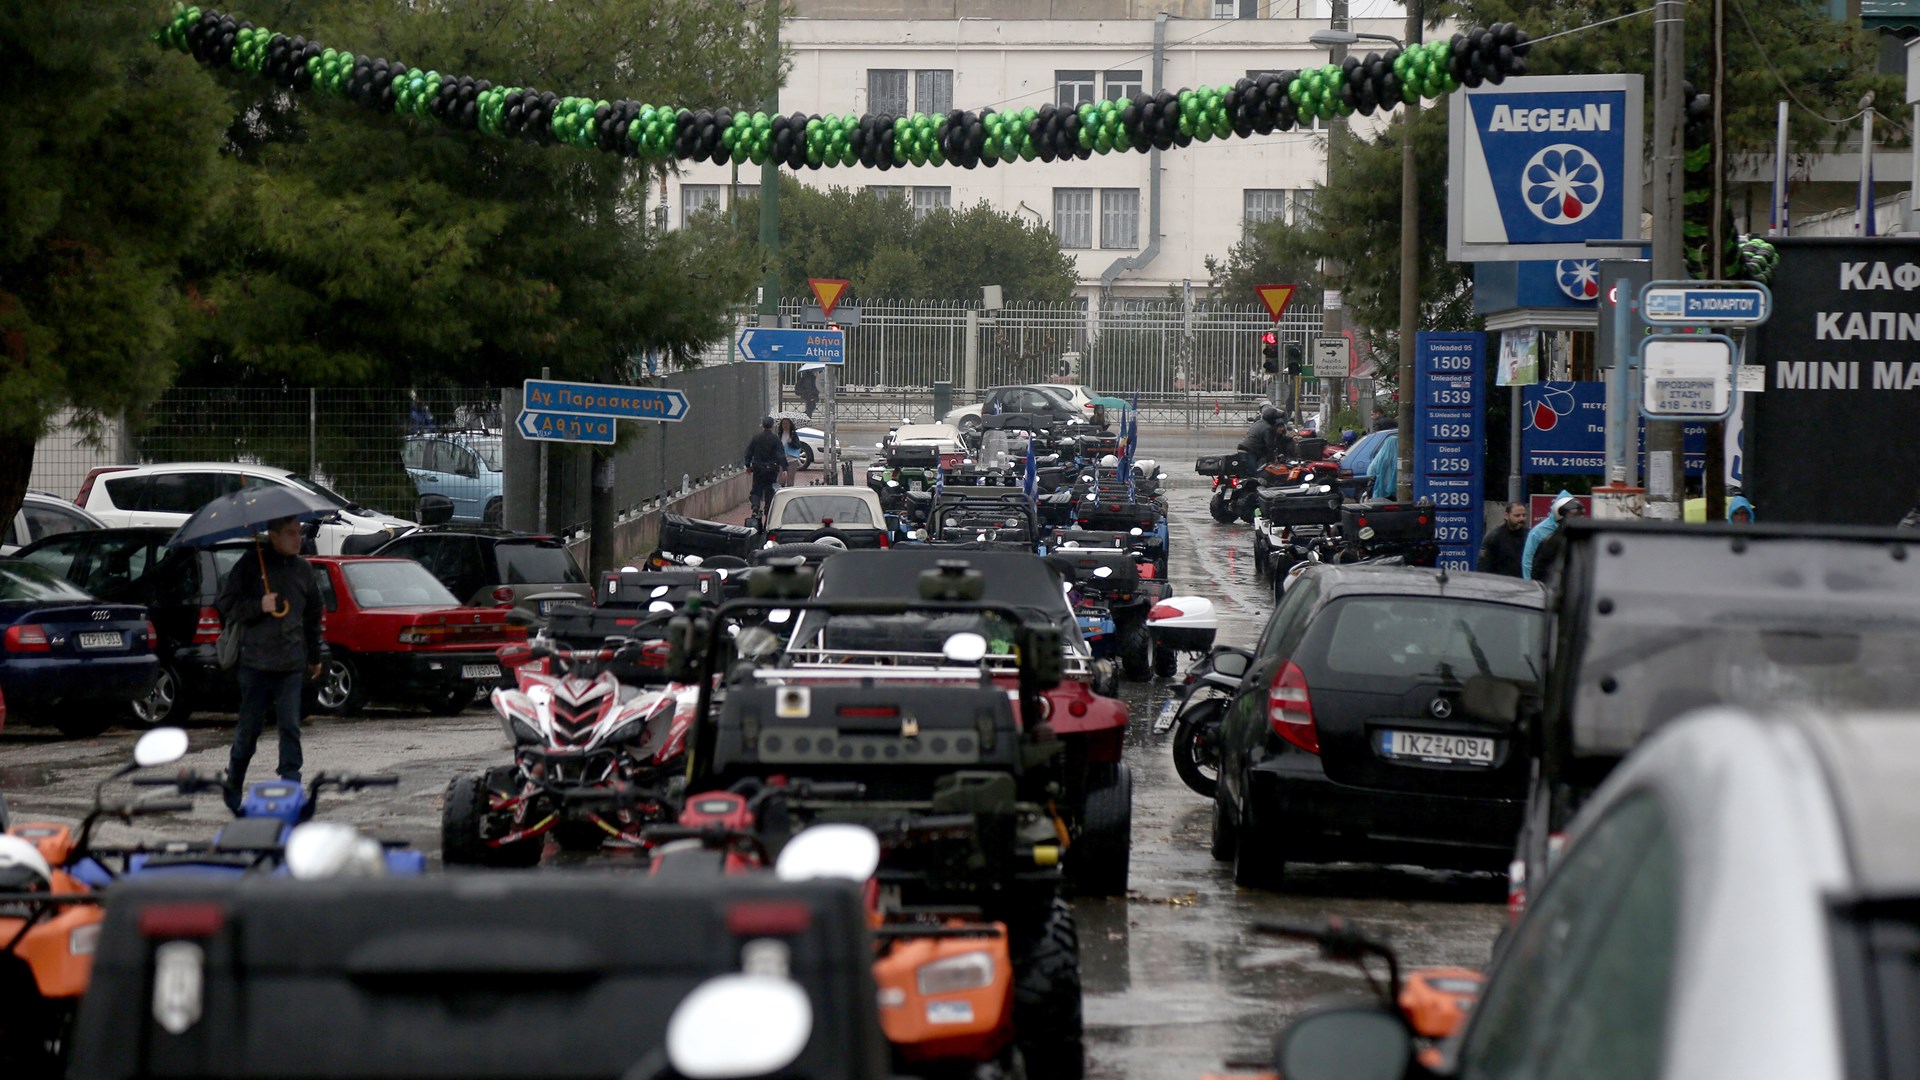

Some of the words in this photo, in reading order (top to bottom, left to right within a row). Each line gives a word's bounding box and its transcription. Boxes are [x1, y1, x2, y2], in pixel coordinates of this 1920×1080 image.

[1488, 103, 1611, 132] AEGEAN
[1702, 299, 1755, 310] ΧΟΛΑΡΓΟΥ
[1816, 311, 1920, 341] ΚΑΠΝ
[806, 335, 841, 347] Αθήνα
[805, 347, 841, 357] Athina
[1776, 360, 1860, 390] MINI
[1656, 380, 1714, 390] ΠΡΟΣΩΡΙΝΗ
[1669, 390, 1701, 399] ΣΤΑΣΗ
[531, 388, 554, 407] Αγ.
[558, 389, 665, 414] Παρασκευή
[1659, 400, 1680, 409] 418
[1691, 400, 1712, 409] 419
[542, 416, 608, 435] Αθήνα
